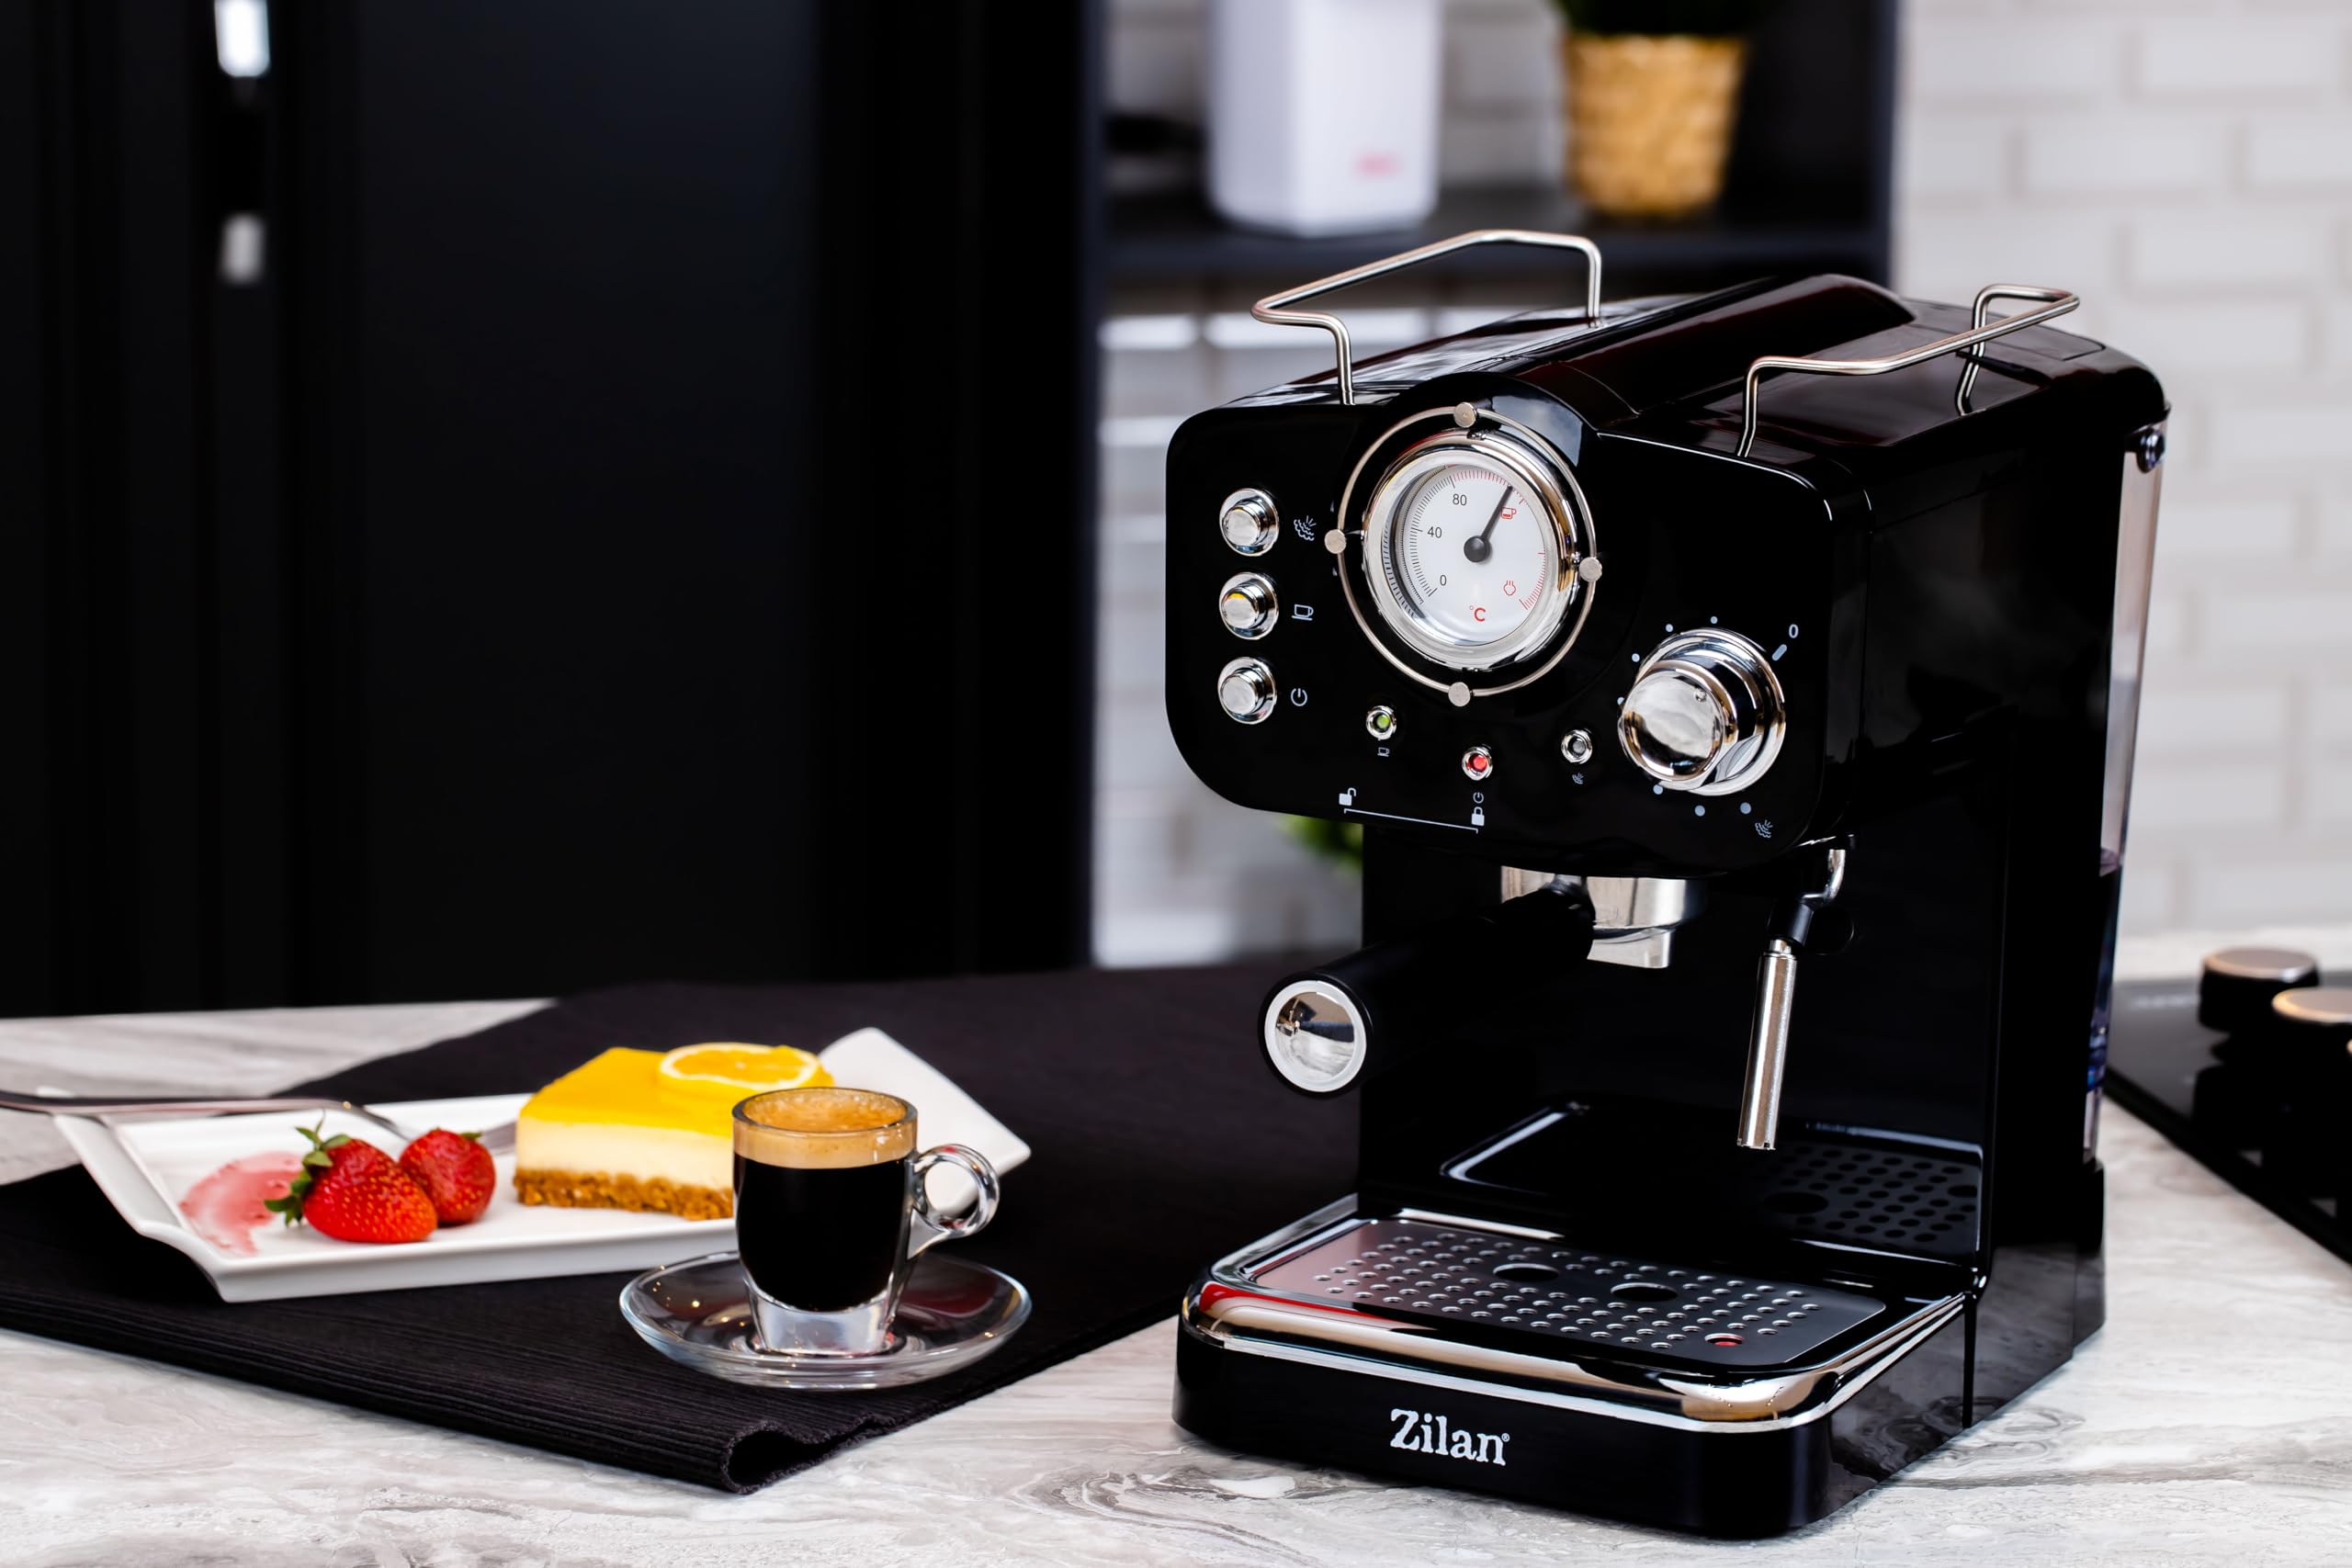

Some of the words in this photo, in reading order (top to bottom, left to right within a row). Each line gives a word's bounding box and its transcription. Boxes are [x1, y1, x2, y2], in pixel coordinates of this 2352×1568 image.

[1453, 493, 1467, 506] 80
[1427, 526, 1442, 538] 40
[1439, 574, 1447, 586] 0
[1788, 624, 1799, 638] 0
